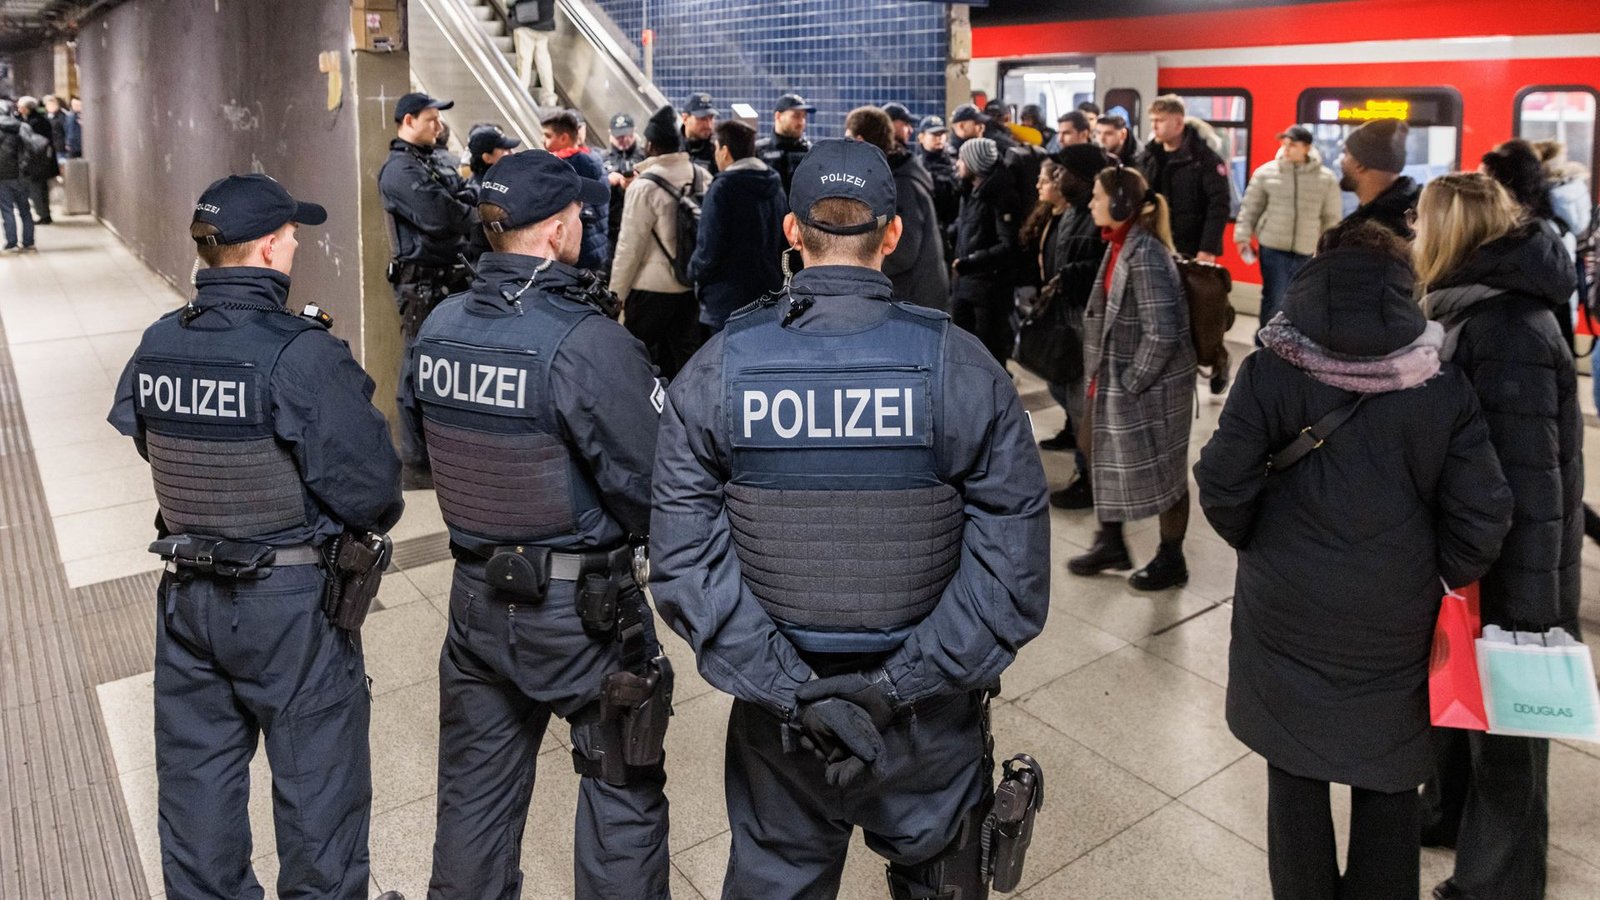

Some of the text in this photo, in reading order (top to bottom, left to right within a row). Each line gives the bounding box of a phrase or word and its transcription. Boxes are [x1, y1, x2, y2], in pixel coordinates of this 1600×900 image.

[820, 172, 866, 188] POLIZEI
[139, 373, 246, 418] POLIZEI
[419, 354, 527, 409] POLIZEI
[743, 388, 913, 439] POLIZEI
[1513, 702, 1574, 718] DOUGLAS
